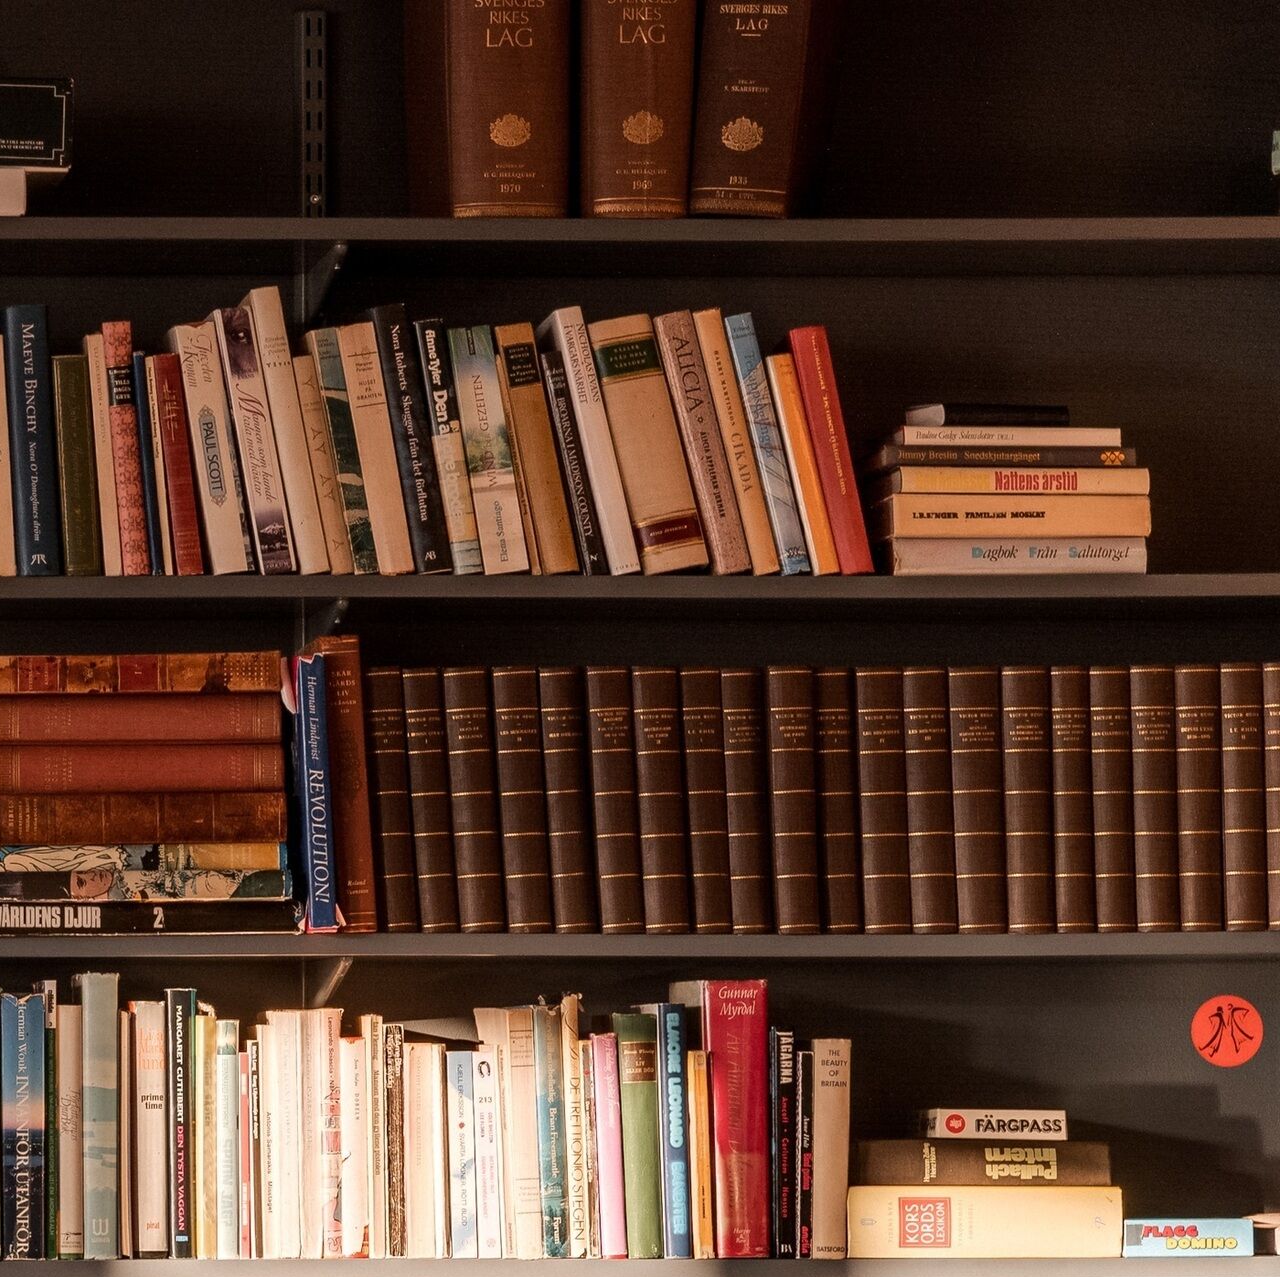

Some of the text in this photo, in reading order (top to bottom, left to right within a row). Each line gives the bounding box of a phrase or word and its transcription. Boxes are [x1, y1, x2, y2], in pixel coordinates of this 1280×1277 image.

[489, 10, 530, 25] RIKES
[622, 8, 662, 21] RIKES
[720, 5, 788, 15] SVERIGES RIKES
[619, 24, 666, 44] LAG
[735, 18, 769, 30] LAG
[486, 26, 533, 48] LAG
[21, 324, 37, 434] MAEVE BINCHY
[673, 336, 703, 413] ALICIA
[471, 375, 488, 431] GEZEITEN
[390, 325, 429, 521] Nora Roberts Skuggor från det förflutna
[203, 421, 222, 491] PAUL SCOTT
[731, 433, 753, 493] CIKADA
[995, 471, 1040, 491] Nattens
[1042, 470, 1078, 491] årstid
[972, 546, 1129, 561] Dagbok Från Salutorget
[307, 676, 329, 902] Herman Lindqvist REVOLUTION!
[65, 905, 101, 928] DJUR
[153, 906, 163, 928] 2
[718, 986, 758, 1000] Gunnar
[720, 1003, 755, 1020] Myrdal
[176, 1005, 184, 1064] MARGARET
[777, 1031, 793, 1084] JÄGARNA
[828, 1049, 841, 1057] THE
[141, 1094, 164, 1102] prime
[667, 1013, 686, 1234] ELMORE LEONARD BANDITER
[975, 1115, 1062, 1133] FÄRGPASS
[15, 1074, 31, 1251] INNANFÖR, UTANFÖR
[177, 1186, 185, 1230] VAGGAN
[905, 1203, 919, 1243] KORS
[921, 1204, 934, 1243] ORDS
[936, 1201, 945, 1243] LEXIKON
[1141, 1226, 1198, 1238] FLAGG
[1166, 1238, 1238, 1250] DOMINO
